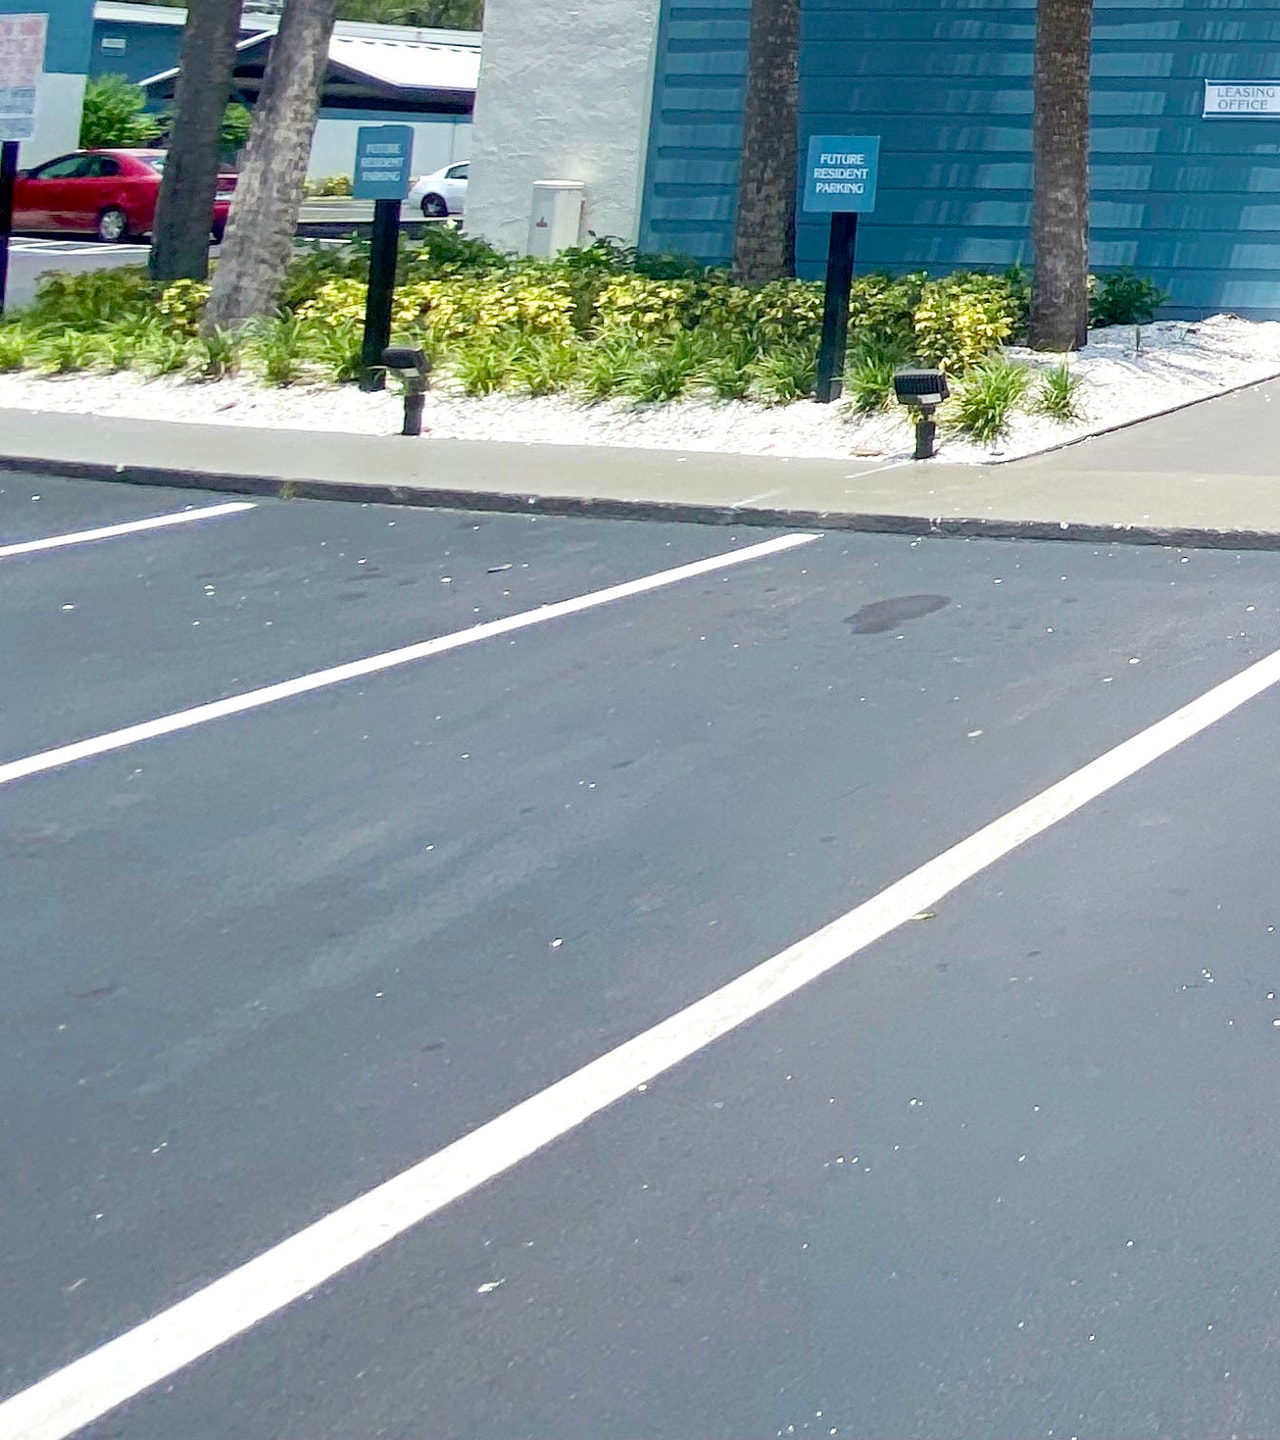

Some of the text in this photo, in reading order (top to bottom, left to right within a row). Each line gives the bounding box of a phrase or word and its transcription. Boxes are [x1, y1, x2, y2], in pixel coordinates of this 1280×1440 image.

[1217, 87, 1275, 98] LEASING
[1218, 99, 1269, 110] OFFICE
[820, 153, 865, 165] FUTURE
[813, 167, 869, 179] RESIDENT
[816, 182, 864, 194] PARKING
